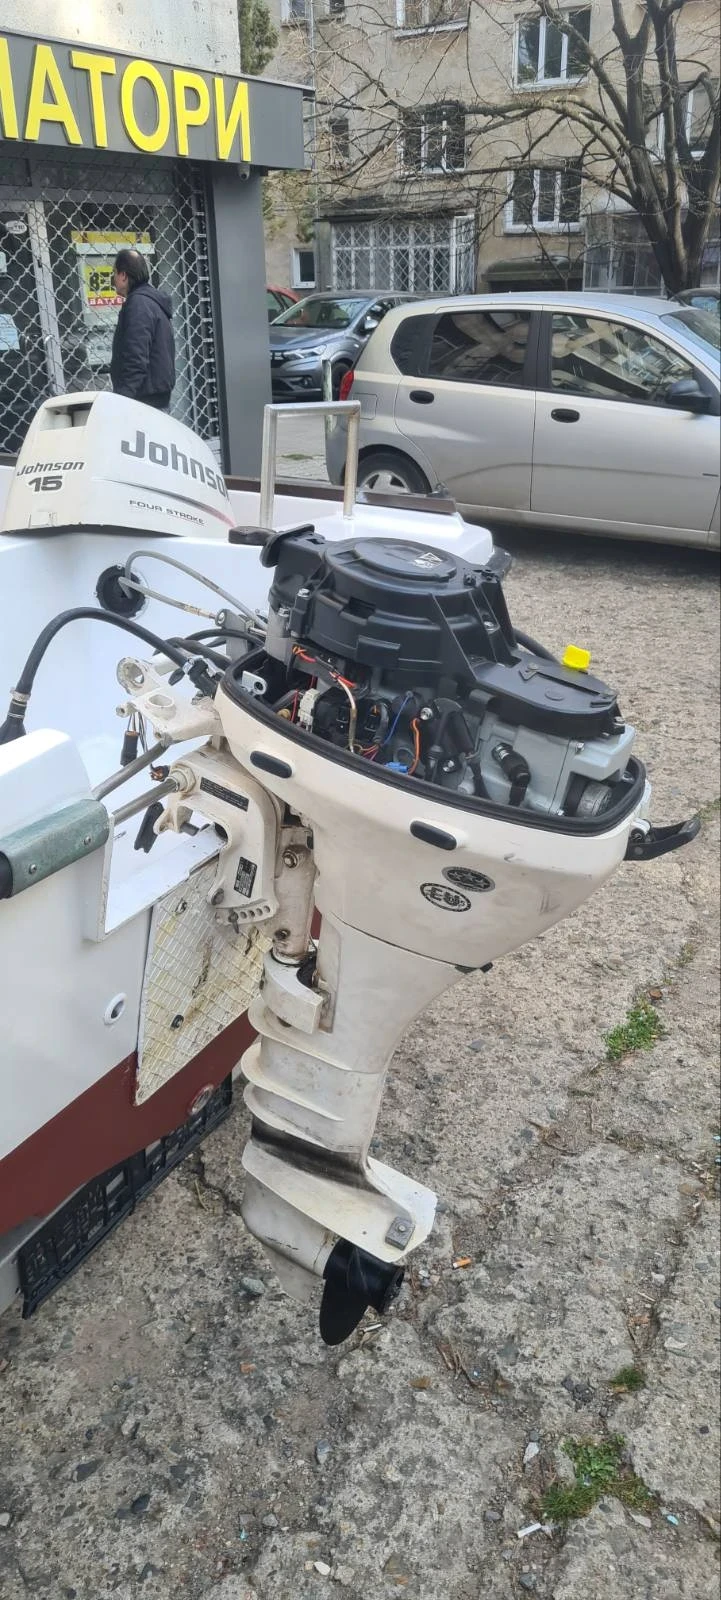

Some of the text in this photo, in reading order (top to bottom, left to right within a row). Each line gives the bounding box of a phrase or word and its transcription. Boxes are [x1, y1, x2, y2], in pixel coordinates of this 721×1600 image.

[16, 461, 85, 476] Johnson
[28, 475, 63, 492] 15
[129, 500, 205, 524] FOUR STROKE
